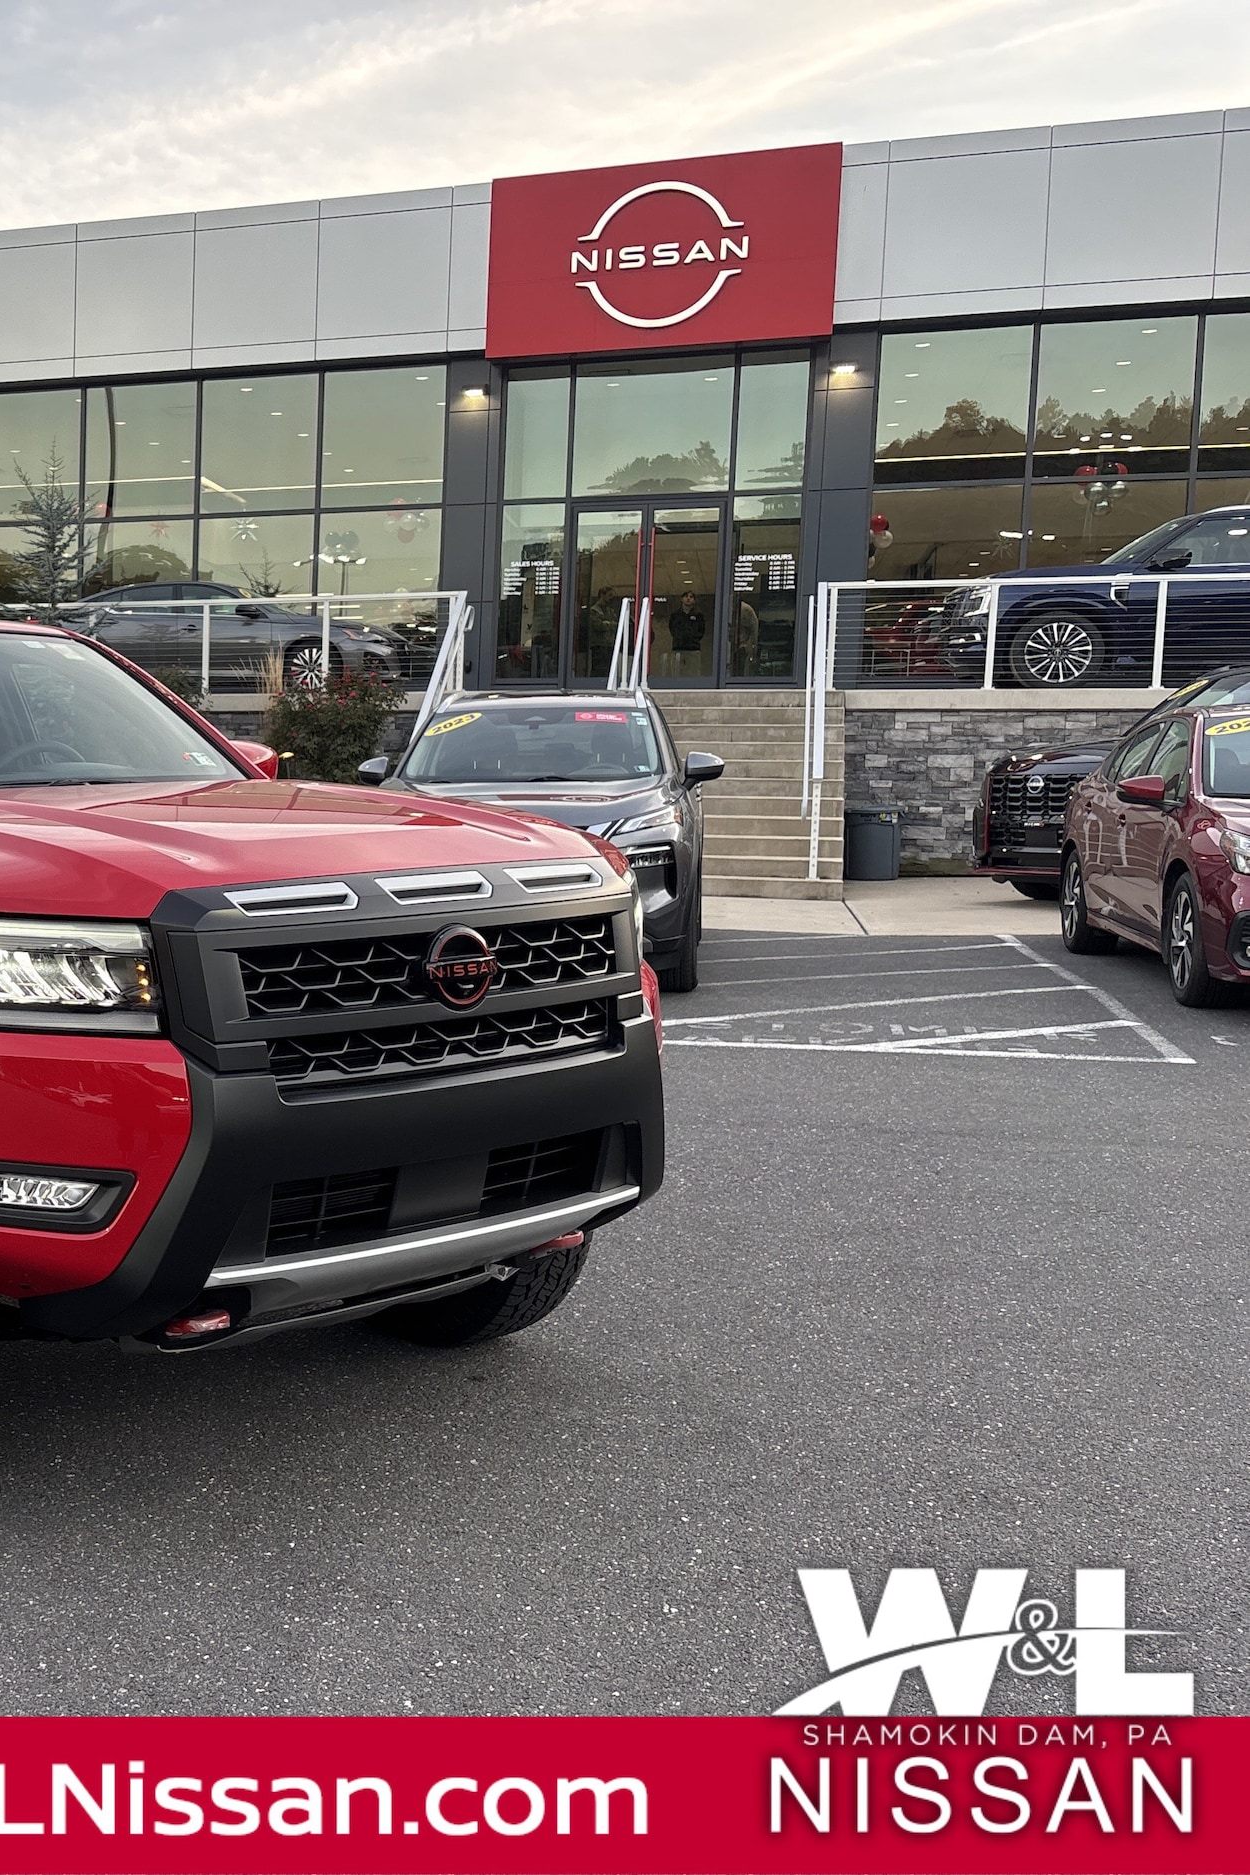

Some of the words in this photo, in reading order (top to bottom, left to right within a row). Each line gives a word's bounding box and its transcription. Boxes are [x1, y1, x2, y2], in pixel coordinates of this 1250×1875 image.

[571, 235, 749, 273] NISSAN
[1214, 720, 1250, 734] 202
[429, 961, 497, 979] NISSAN
